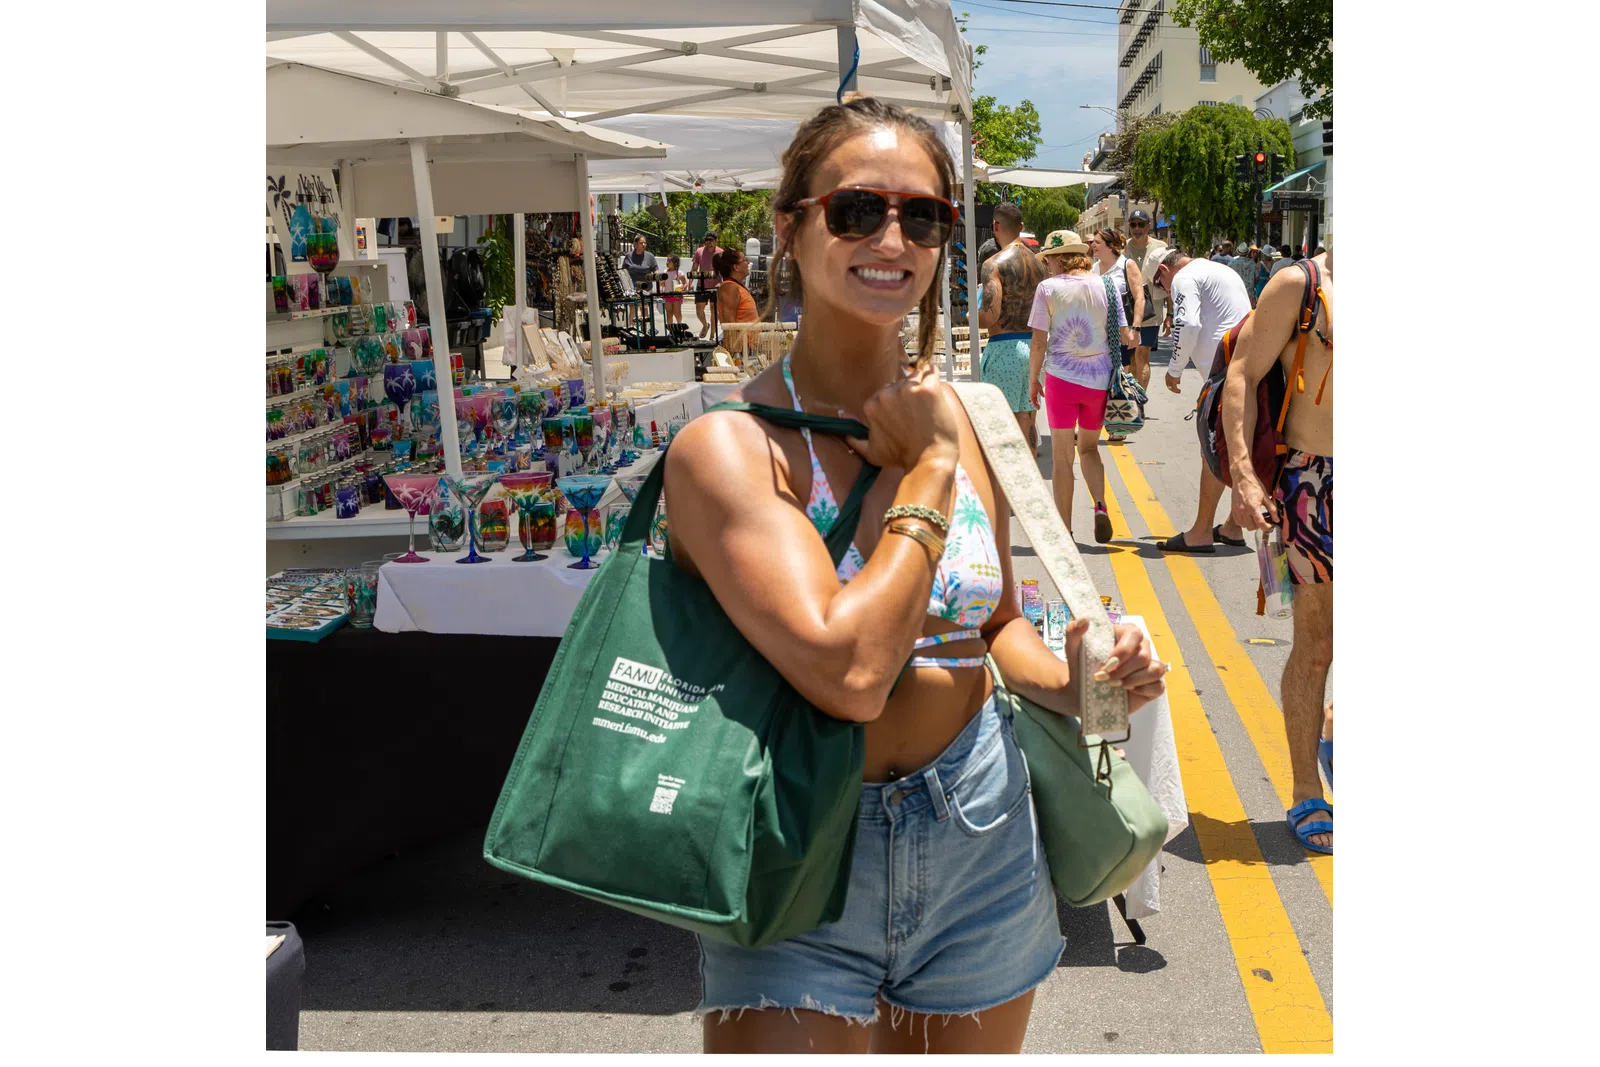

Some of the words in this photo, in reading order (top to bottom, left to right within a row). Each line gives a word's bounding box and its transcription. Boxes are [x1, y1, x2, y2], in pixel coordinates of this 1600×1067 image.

[614, 662, 658, 685] FAMU
[661, 672, 706, 694] FLORIDA
[605, 680, 648, 699] MEDICAL
[657, 682, 713, 703] UNIVERSIY
[598, 700, 644, 719] RESEARCH
[602, 690, 656, 711] EDUCATION
[655, 706, 679, 721] AND
